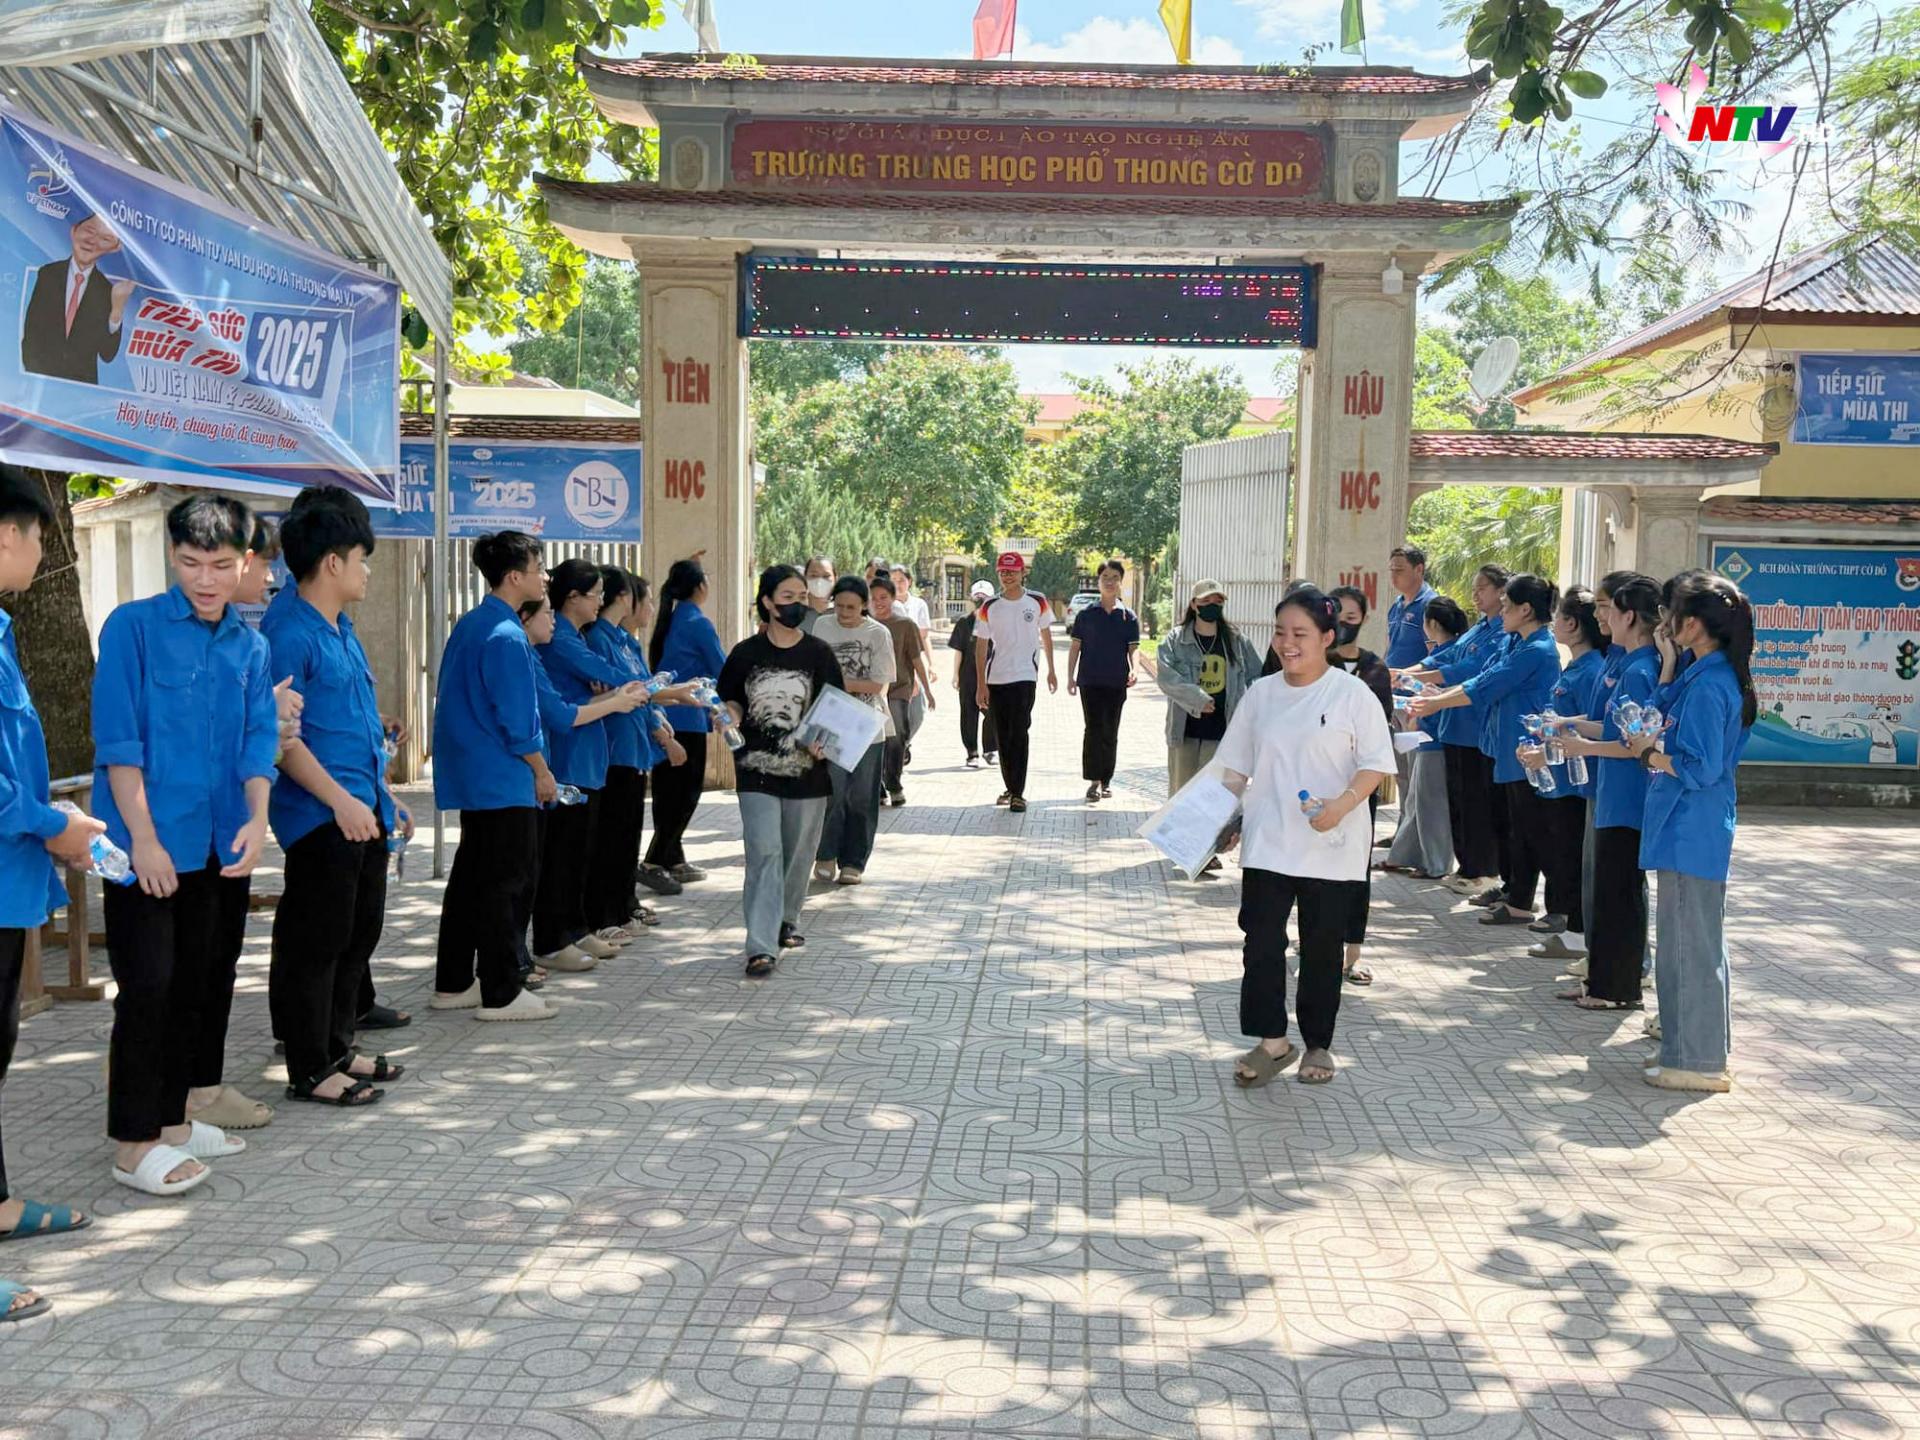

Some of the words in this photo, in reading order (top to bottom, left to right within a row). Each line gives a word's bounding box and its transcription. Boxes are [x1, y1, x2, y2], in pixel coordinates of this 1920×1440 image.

[877, 154, 971, 181] TRUNG
[980, 155, 1036, 187] HỌC
[1046, 148, 1111, 182] PHỔ
[1218, 152, 1257, 186] CỜ
[1265, 152, 1304, 186] ĐỎ
[111, 200, 143, 230] CÔNG
[145, 215, 159, 236] TY
[243, 255, 256, 276] DU
[258, 262, 277, 285] HỌC
[277, 266, 289, 286] VÀ
[207, 308, 247, 343] SỨC
[128, 329, 194, 362] MÙA
[190, 348, 241, 376] THI
[256, 316, 329, 391] 2025
[161, 367, 188, 403] VIỆT
[193, 374, 224, 403] NAM
[662, 357, 711, 404] TIÊN
[1344, 370, 1384, 420] HẬU
[1817, 367, 1852, 396] TIẾP
[1855, 370, 1886, 396] SỨC
[116, 401, 142, 429] Hãy
[144, 408, 159, 430] tự
[183, 415, 219, 440] chúng
[221, 422, 237, 440] tôi
[238, 425, 249, 442] đi
[251, 428, 275, 449] cùng
[1842, 397, 1879, 422] MÙA
[1882, 400, 1909, 422] THI
[475, 480, 537, 509] 2025
[665, 459, 707, 504] HỌC
[1339, 471, 1381, 514] HỌC
[1755, 599, 1800, 630] TRƯỜNG
[1802, 605, 1820, 630] AN
[1821, 602, 1851, 631] TOÀN
[1854, 606, 1881, 632] GIAO
[1884, 603, 1920, 633] THÔNG
